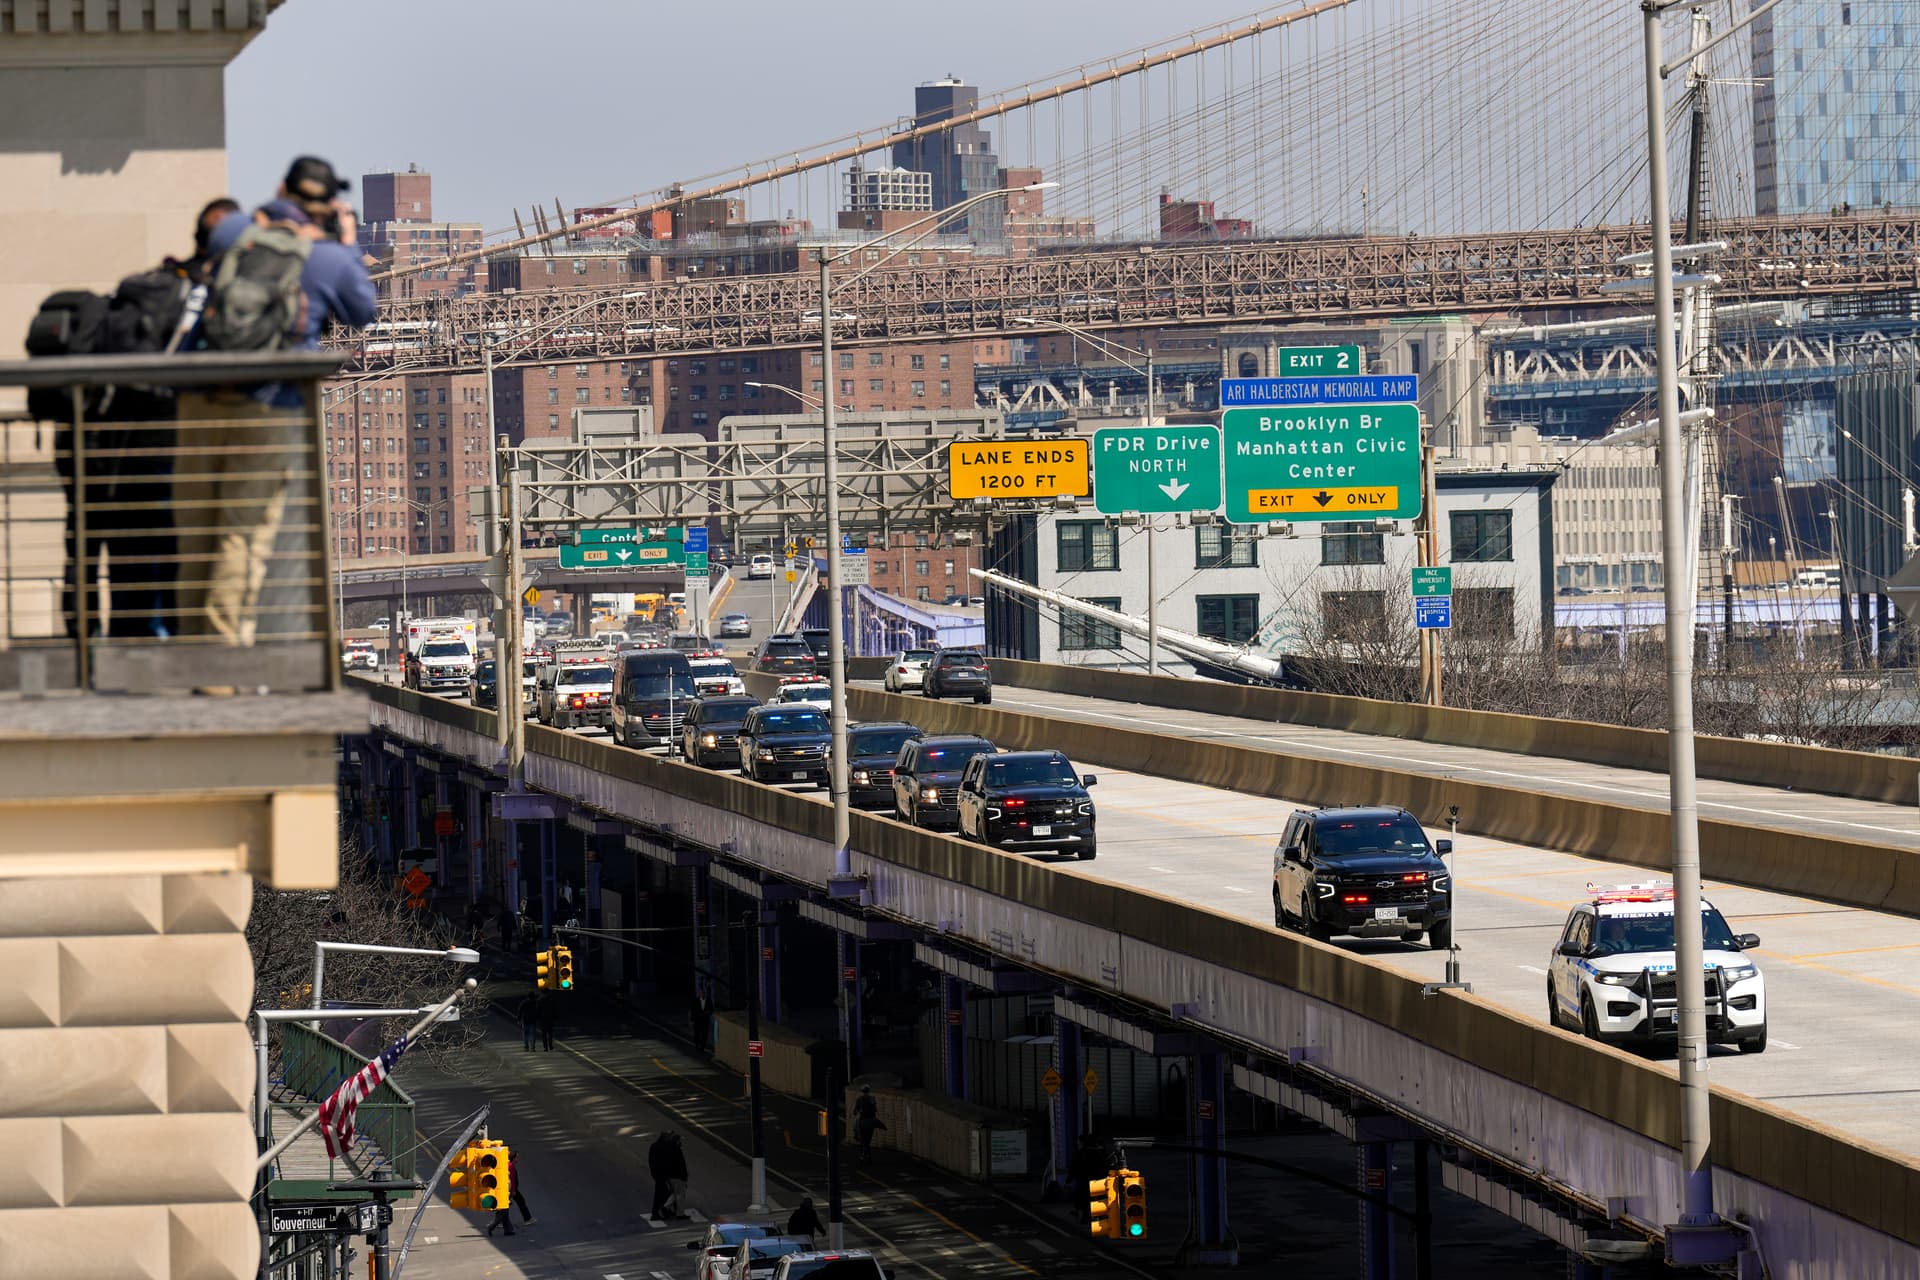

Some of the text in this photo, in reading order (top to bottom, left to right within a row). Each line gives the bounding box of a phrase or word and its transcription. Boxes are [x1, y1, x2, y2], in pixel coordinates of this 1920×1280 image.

[1290, 352, 1349, 369] EXIT 2
[1227, 381, 1412, 400] ARI HALBERSTAM MEMORIAL RAMP
[1260, 414, 1382, 433] Brooklyn Br
[1103, 436, 1210, 452] FDR Drive
[1237, 437, 1407, 456] Manhattan Civic
[961, 450, 1075, 465] LANE ENDS
[1129, 459, 1187, 473] NORTH
[1289, 463, 1356, 479] Center
[980, 475, 1057, 489] 1200 FT
[1259, 493, 1386, 507] EXIT ONLY
[587, 550, 664, 560] EXIT ONLY
[1611, 911, 1660, 919] HIGHWAY
[273, 1216, 327, 1231] Gouverneur
